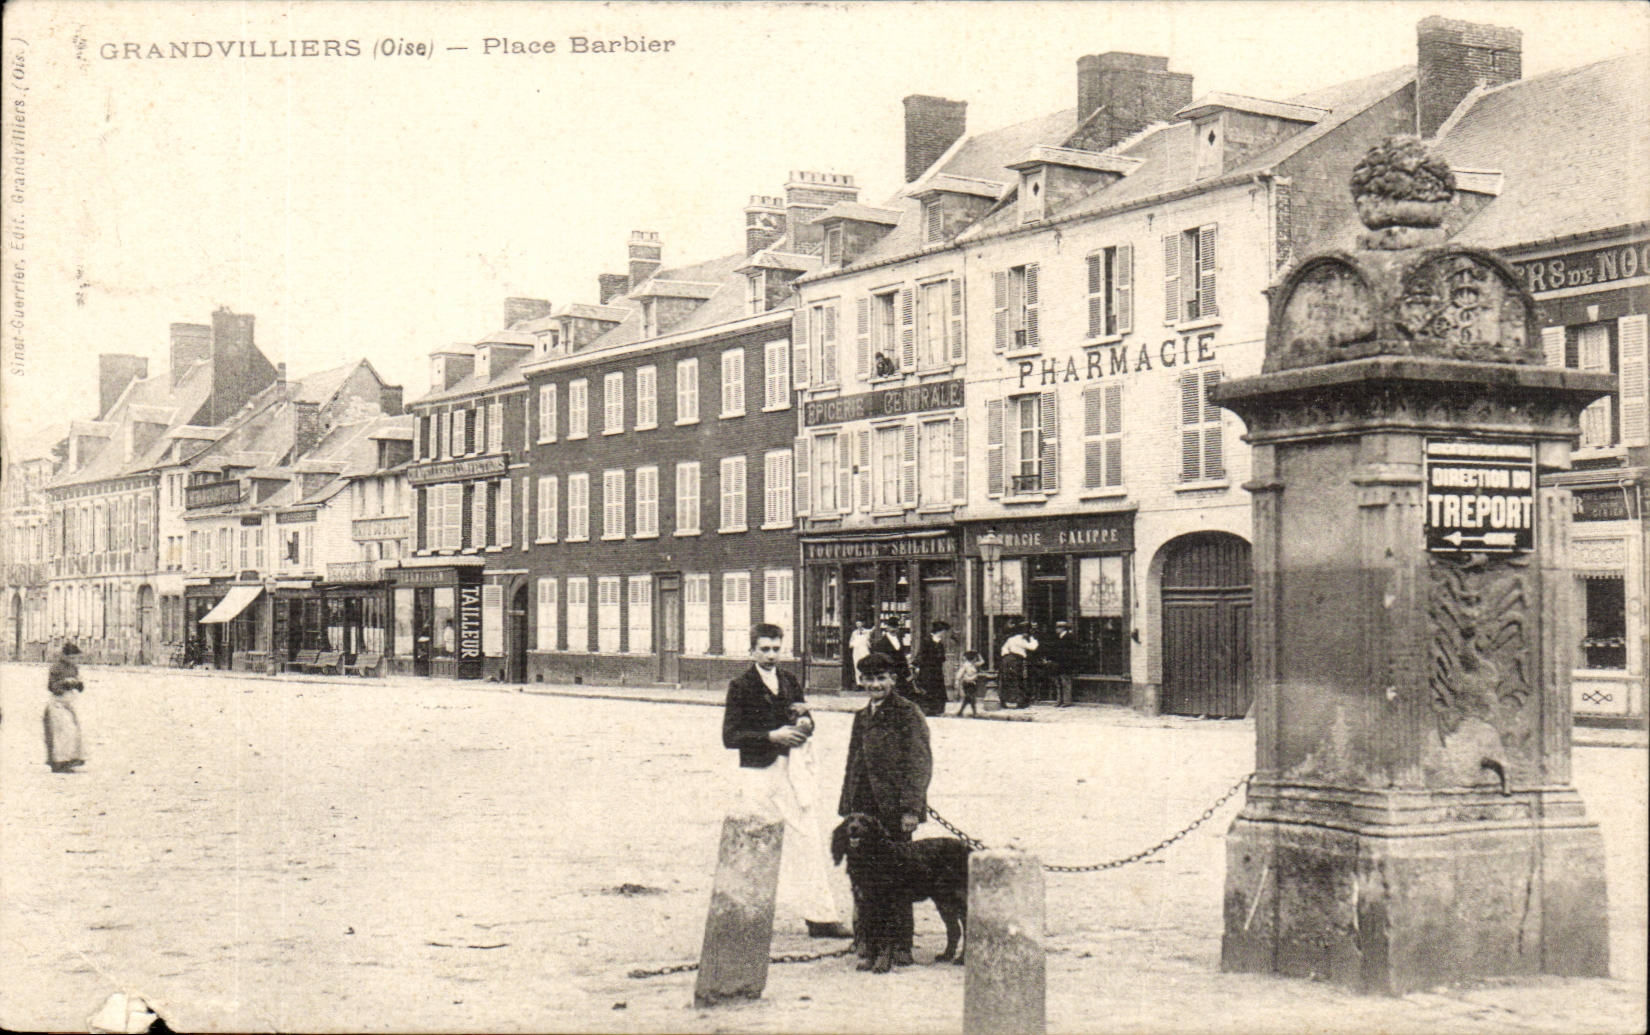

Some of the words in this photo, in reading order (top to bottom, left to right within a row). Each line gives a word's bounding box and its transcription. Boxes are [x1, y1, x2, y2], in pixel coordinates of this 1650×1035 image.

[1018, 331, 1216, 389] PHARMACIE
[884, 382, 962, 415] CENTRALE
[1428, 494, 1533, 528] TREPORT
[461, 586, 480, 658] TAILLEUR
